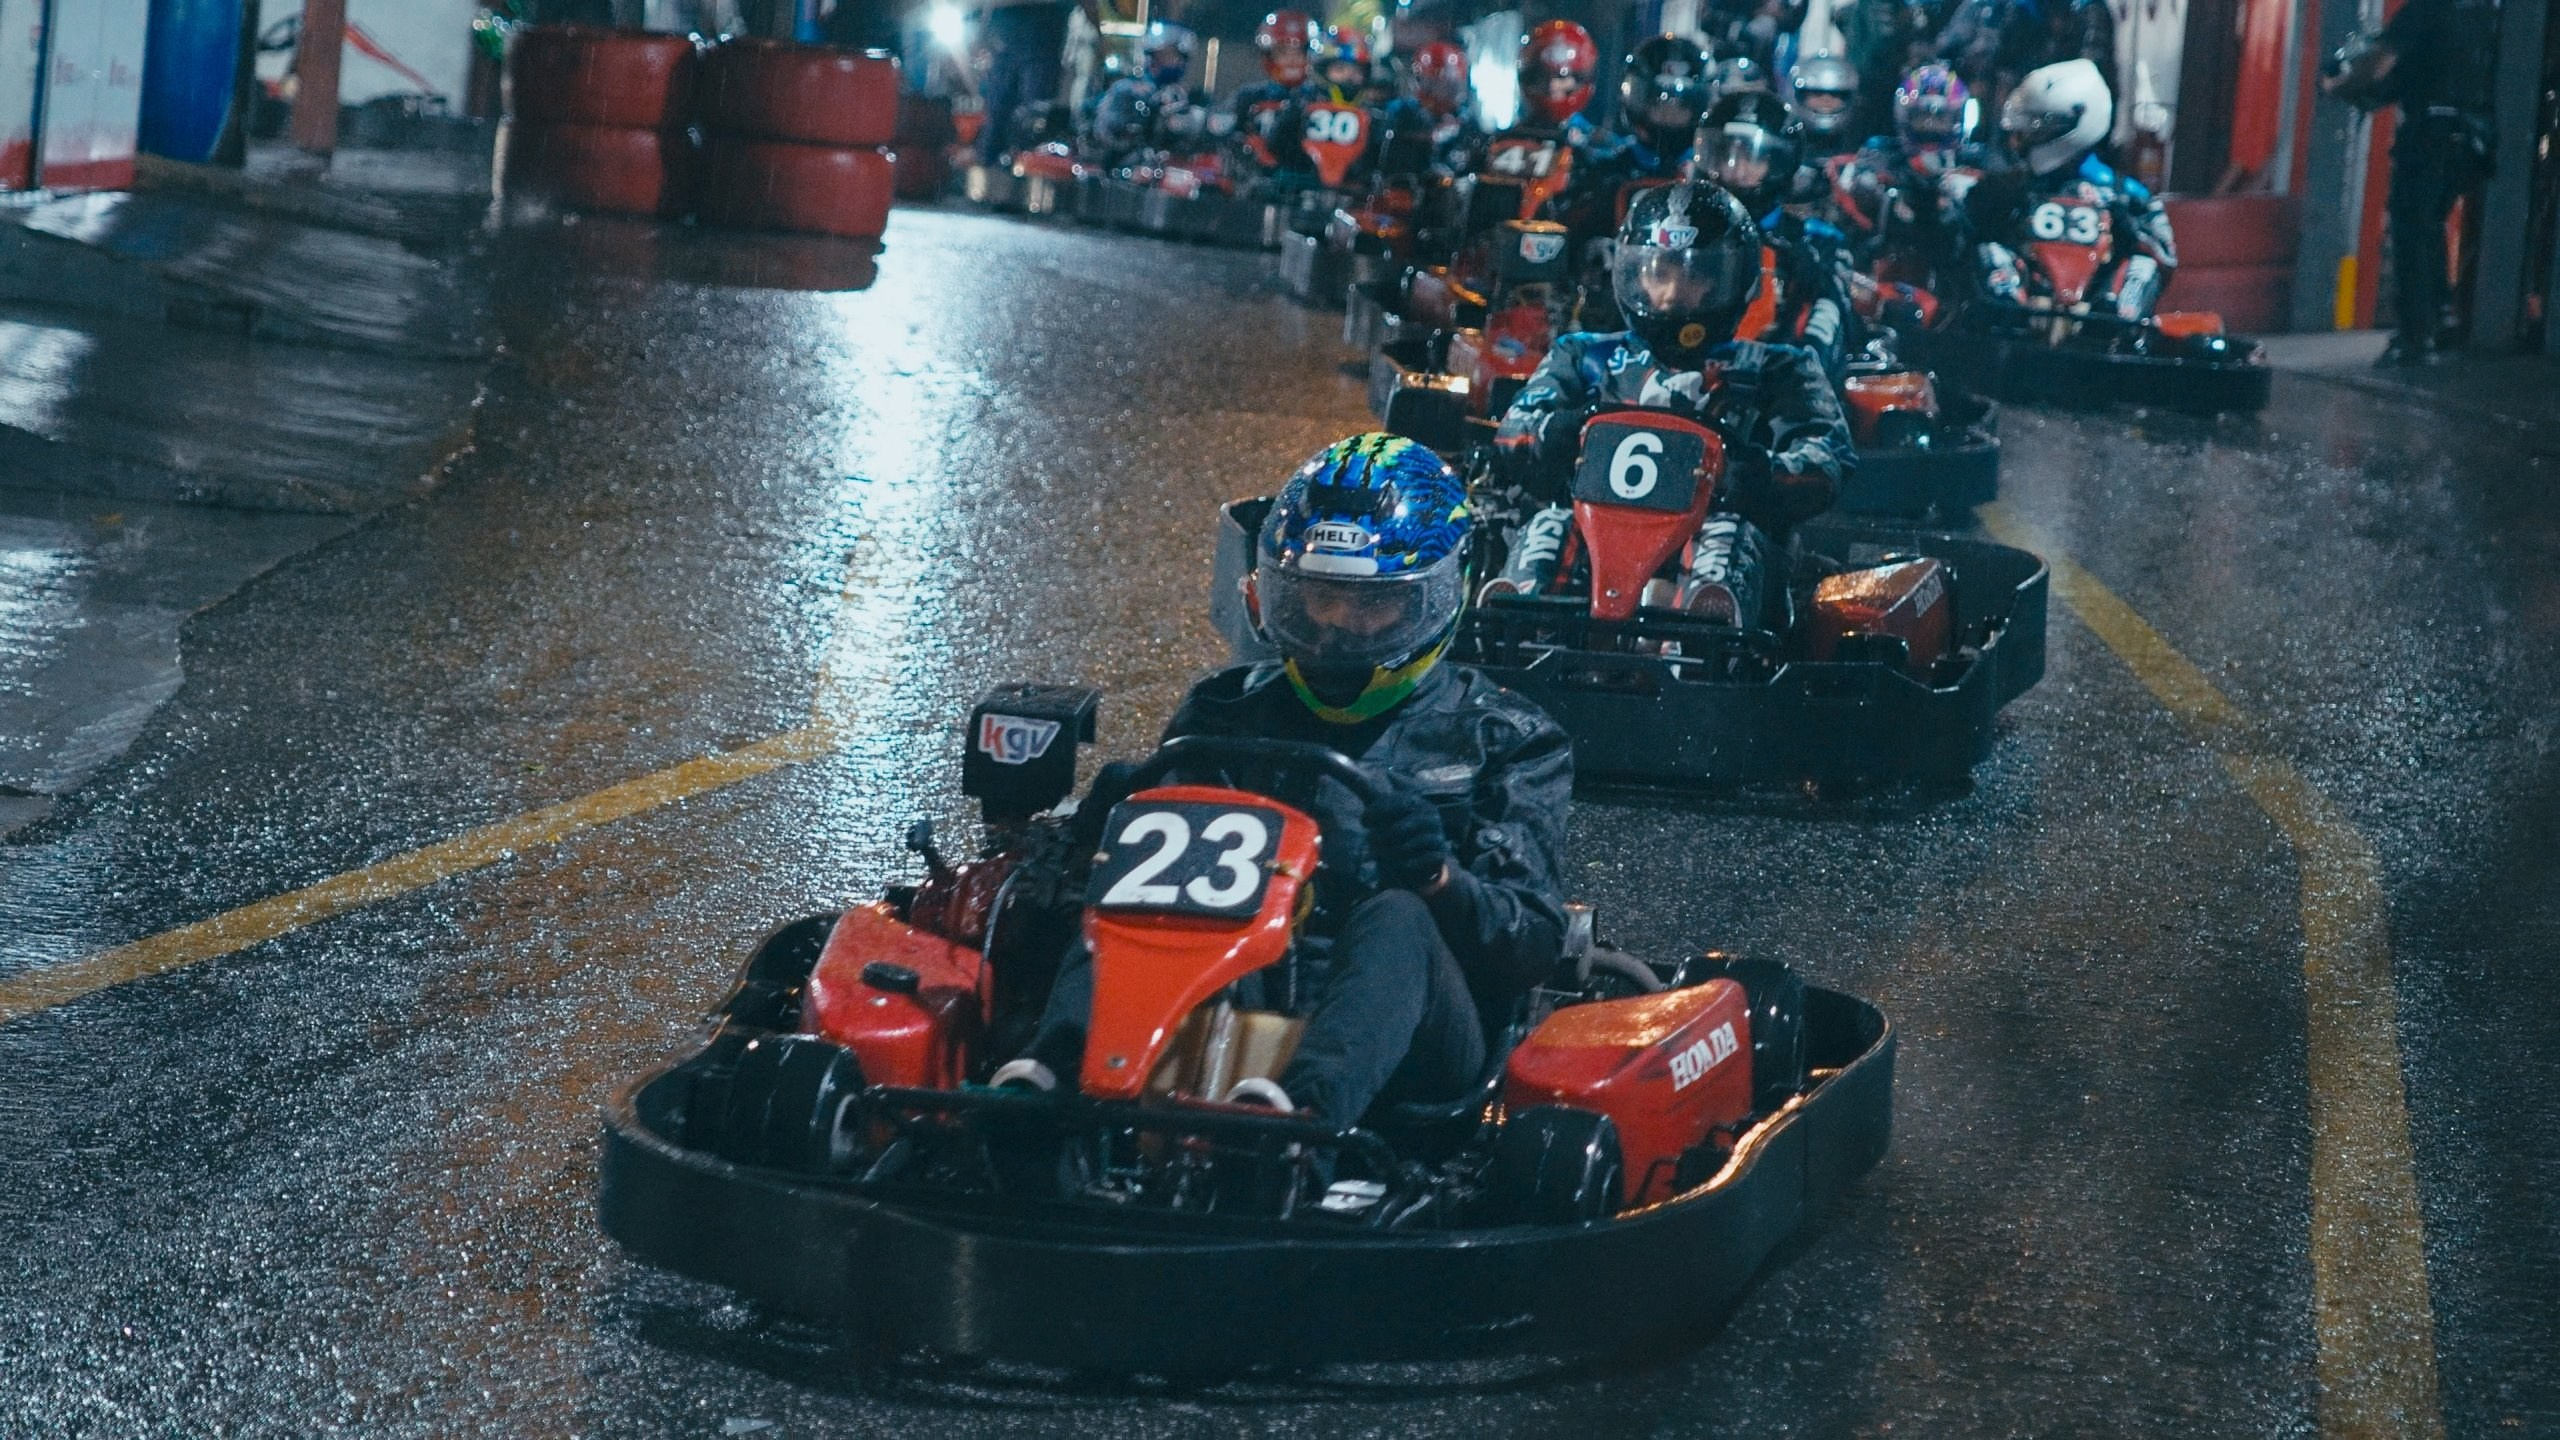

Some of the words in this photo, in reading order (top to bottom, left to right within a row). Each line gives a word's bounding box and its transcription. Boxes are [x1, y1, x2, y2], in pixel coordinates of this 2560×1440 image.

[1306, 109, 1359, 144] 30
[1491, 140, 1556, 177] 41
[2032, 202, 2099, 243] 63
[1609, 431, 1663, 499] 6
[1313, 529, 1360, 544] HELT
[982, 716, 1058, 760] kgv
[1100, 811, 1268, 908] 23
